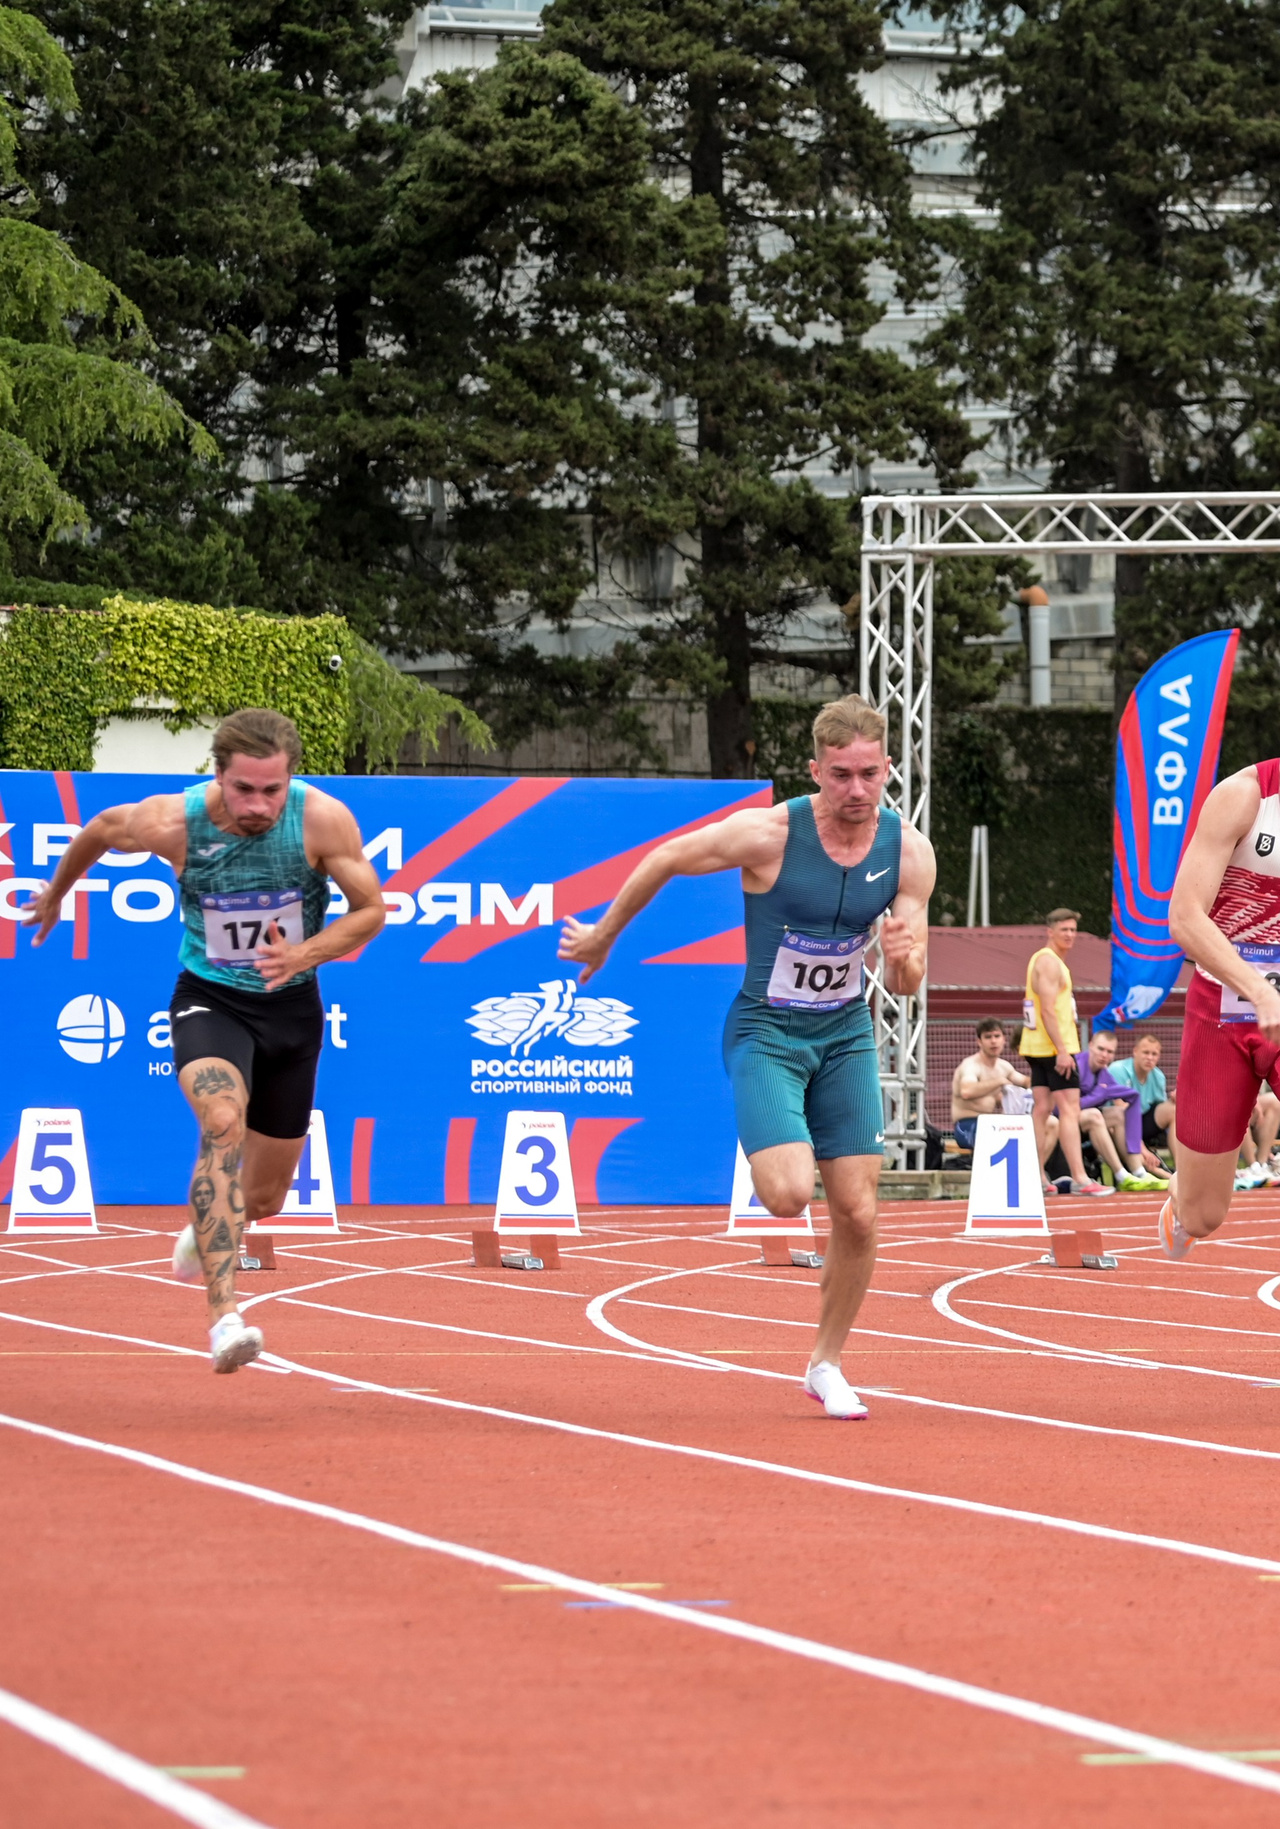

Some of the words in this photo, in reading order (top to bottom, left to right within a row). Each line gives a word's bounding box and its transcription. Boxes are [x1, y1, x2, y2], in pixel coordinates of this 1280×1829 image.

[800, 940, 831, 950] azimut
[1243, 947, 1274, 956] azimut
[793, 962, 850, 992] 102
[471, 1055, 633, 1078] РОССИЙСКИЙ
[470, 1079, 581, 1094] СПОРТИВНЫЙ
[584, 1080, 633, 1096] ФОНД
[29, 1133, 76, 1205] 5
[514, 1135, 560, 1206] 3
[990, 1138, 1020, 1208] 1
